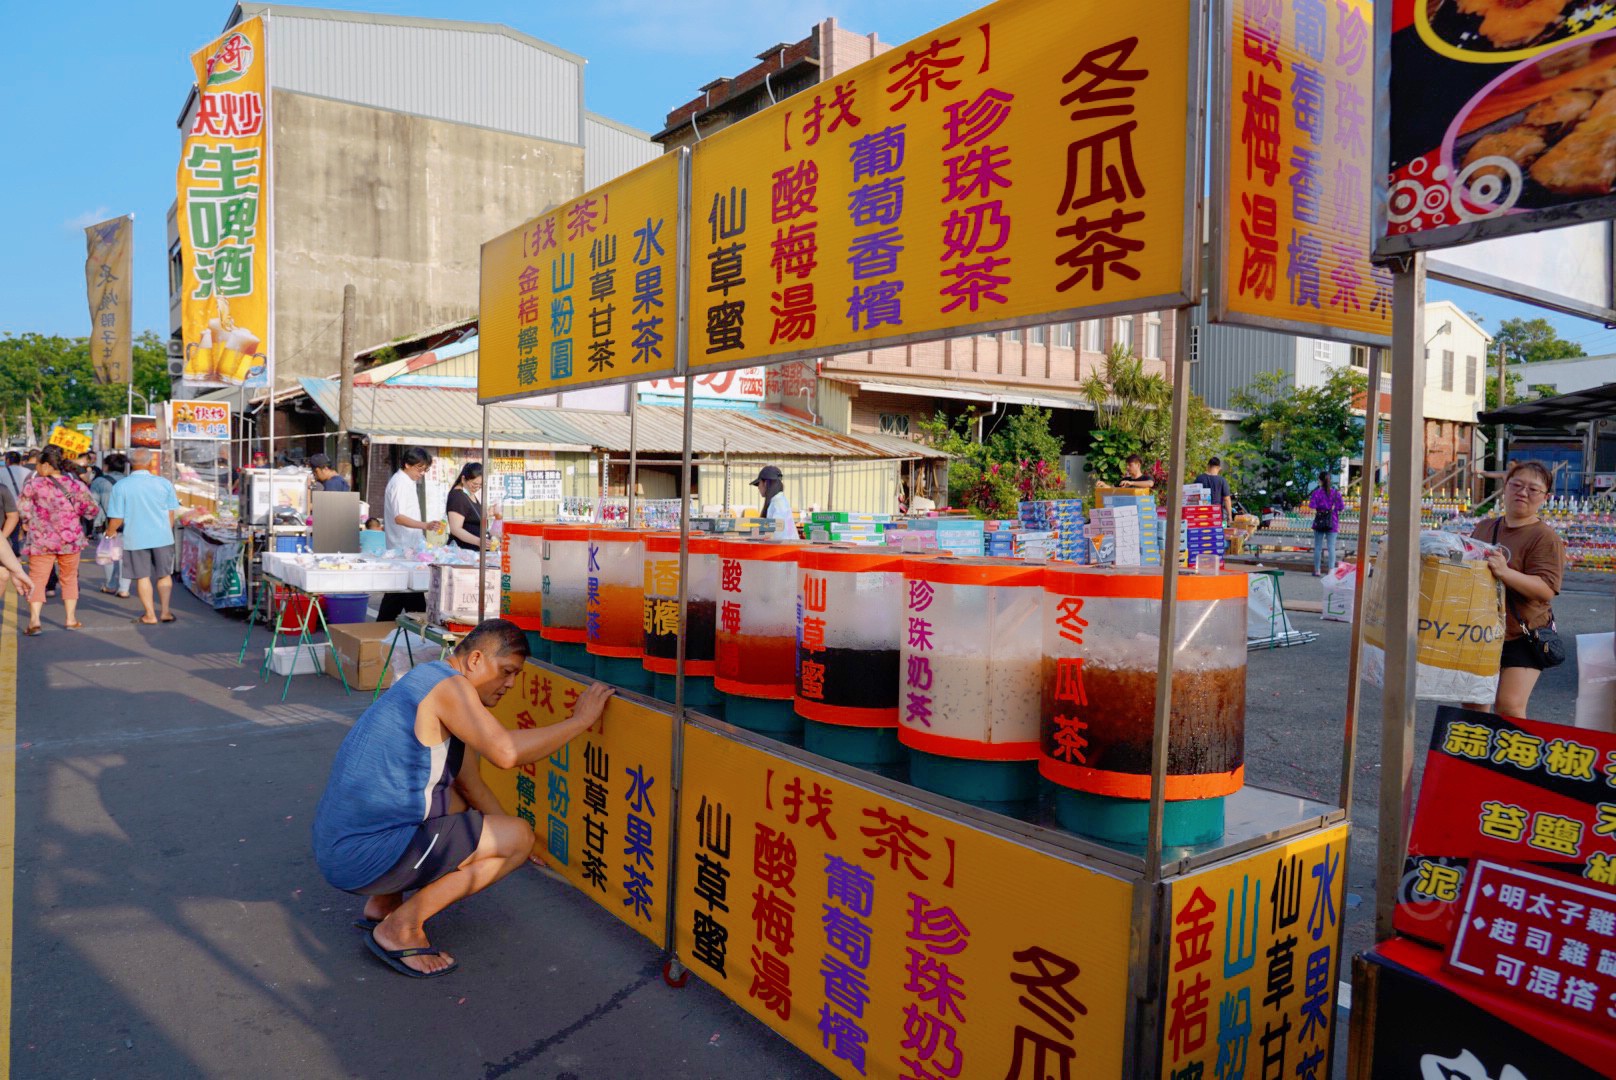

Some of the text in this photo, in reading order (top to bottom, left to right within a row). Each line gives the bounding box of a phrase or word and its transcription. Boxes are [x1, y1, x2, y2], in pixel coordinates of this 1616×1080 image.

[186, 144, 261, 299] 生啤酒
[846, 122, 907, 332] 葡萄香檳
[940, 87, 1015, 314] 珍珠奶茶
[1055, 36, 1149, 293] 冬瓜茶
[517, 265, 540, 387] 金桔檸檬
[549, 252, 575, 381] 山粉圓
[587, 233, 618, 373] 仙草甘茶
[631, 216, 665, 365] 水果茶
[704, 186, 748, 356] 仙草蜜
[768, 159, 819, 346] 酸梅湯
[463, 593, 494, 604] LONON
[586, 542, 600, 640] 水果茶
[801, 573, 827, 699] 仙草蜜
[905, 579, 935, 728] 珍珠奶茶
[1054, 597, 1090, 764] 冬瓜茶
[582, 741, 609, 893] 仙草甘茶
[623, 764, 655, 922] 水果茶
[691, 794, 731, 979] 仙草蜜
[748, 821, 798, 1021] 酸梅湯
[817, 852, 875, 1076] 葡萄香檳
[1168, 886, 1217, 1080] 金桔
